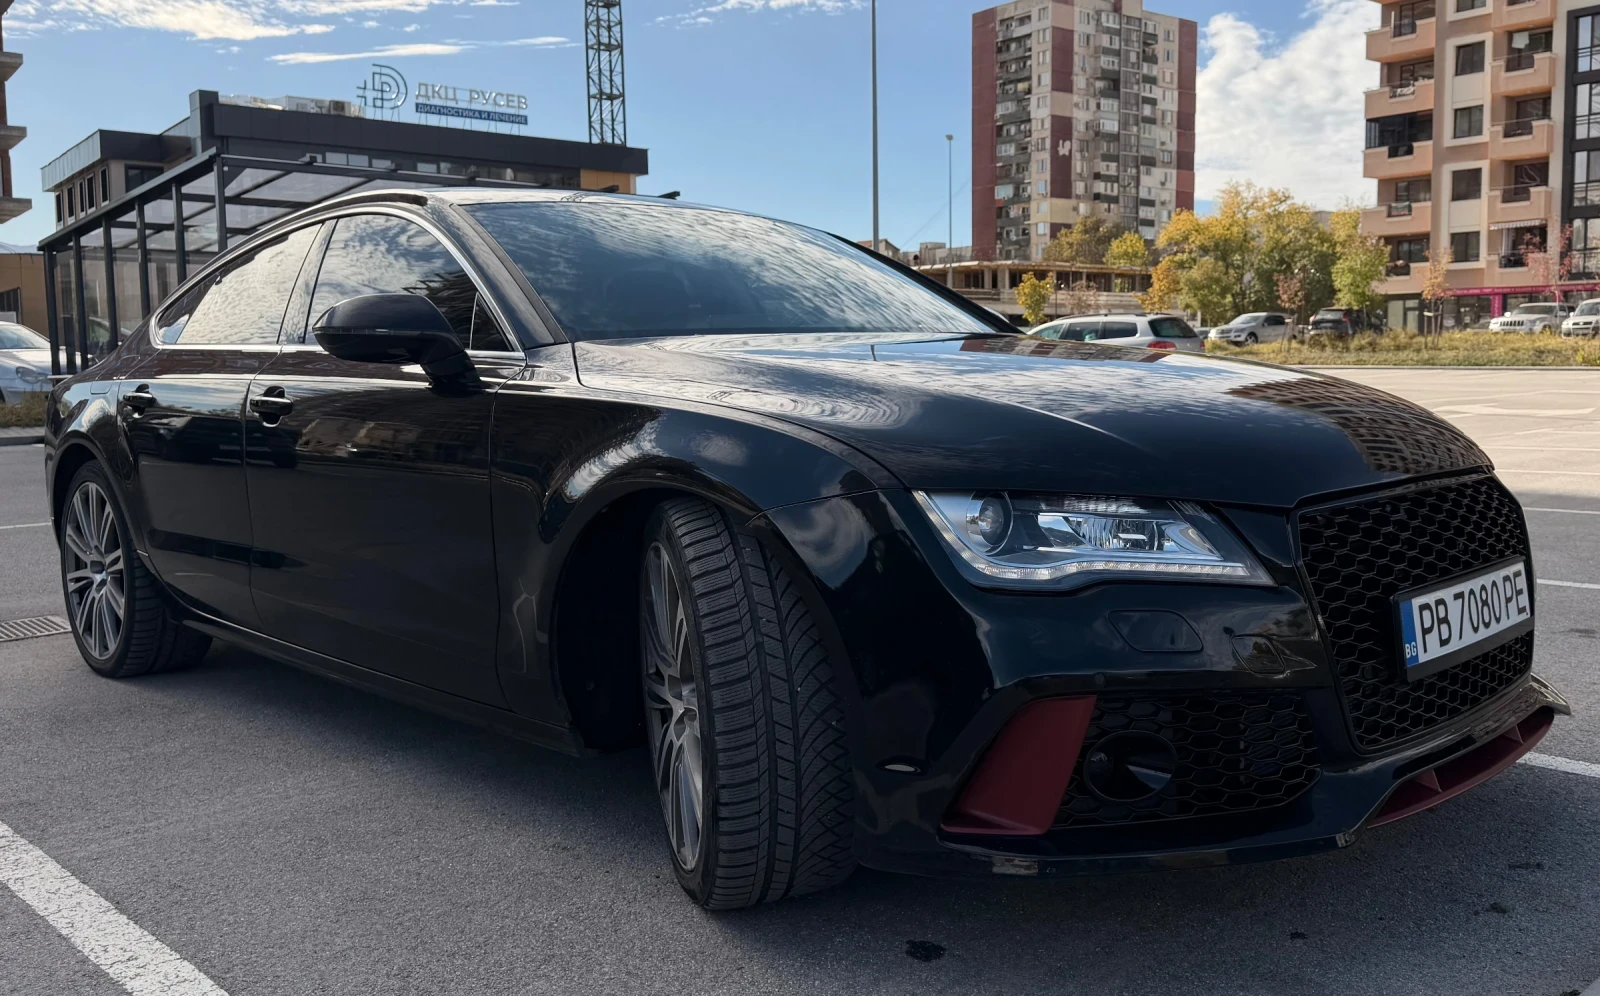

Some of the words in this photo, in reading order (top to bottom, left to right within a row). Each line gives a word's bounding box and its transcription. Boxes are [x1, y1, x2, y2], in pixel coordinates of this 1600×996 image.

[415, 82, 458, 104] ДКЦ
[468, 89, 528, 109] РУСЕВ
[417, 104, 480, 118] ДИАГНОСТИКА
[481, 111, 488, 119] И
[489, 112, 526, 123] ЛЕЧЕНИЕ
[1418, 597, 1452, 654] PB
[1453, 579, 1501, 641] 7080
[1405, 641, 1417, 658] BG
